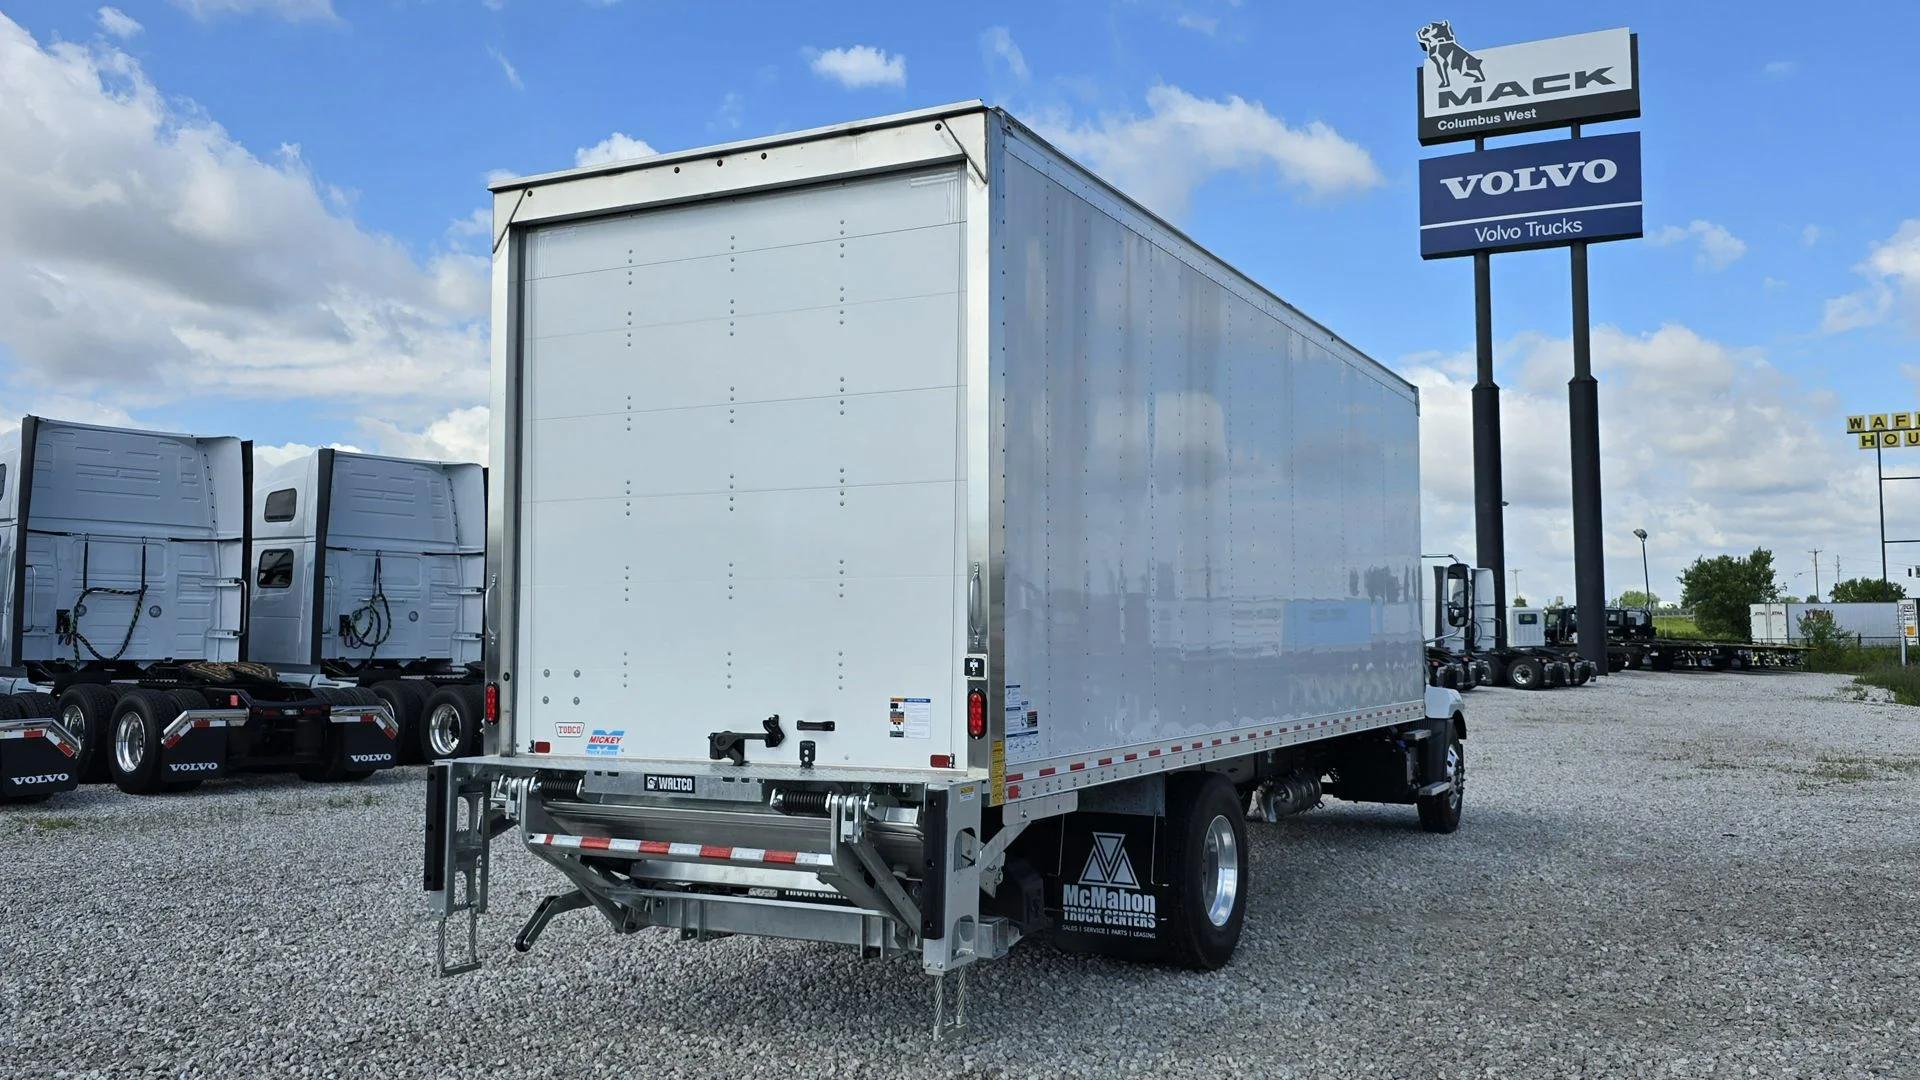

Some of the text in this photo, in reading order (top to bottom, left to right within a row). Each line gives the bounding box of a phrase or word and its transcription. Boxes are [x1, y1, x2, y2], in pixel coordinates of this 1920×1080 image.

[1438, 66, 1616, 109] MACK
[1438, 108, 1537, 131] Columbus West
[1440, 158, 1618, 200] VOLVO
[1475, 218, 1583, 243] Volvo Trucks
[558, 725, 581, 734] TODCO
[588, 736, 622, 744] MICKEY
[350, 753, 392, 762] VOLVO
[169, 762, 218, 772] VOLVO
[11, 773, 70, 785] VOLVO
[659, 776, 693, 791] WALTCO
[1062, 884, 1156, 914] McMahon
[1062, 906, 1156, 929] TRUCK CENTERS
[1062, 924, 1078, 932] SALES
[1083, 926, 1106, 935] SERVICE
[1133, 931, 1156, 939] LEASING
